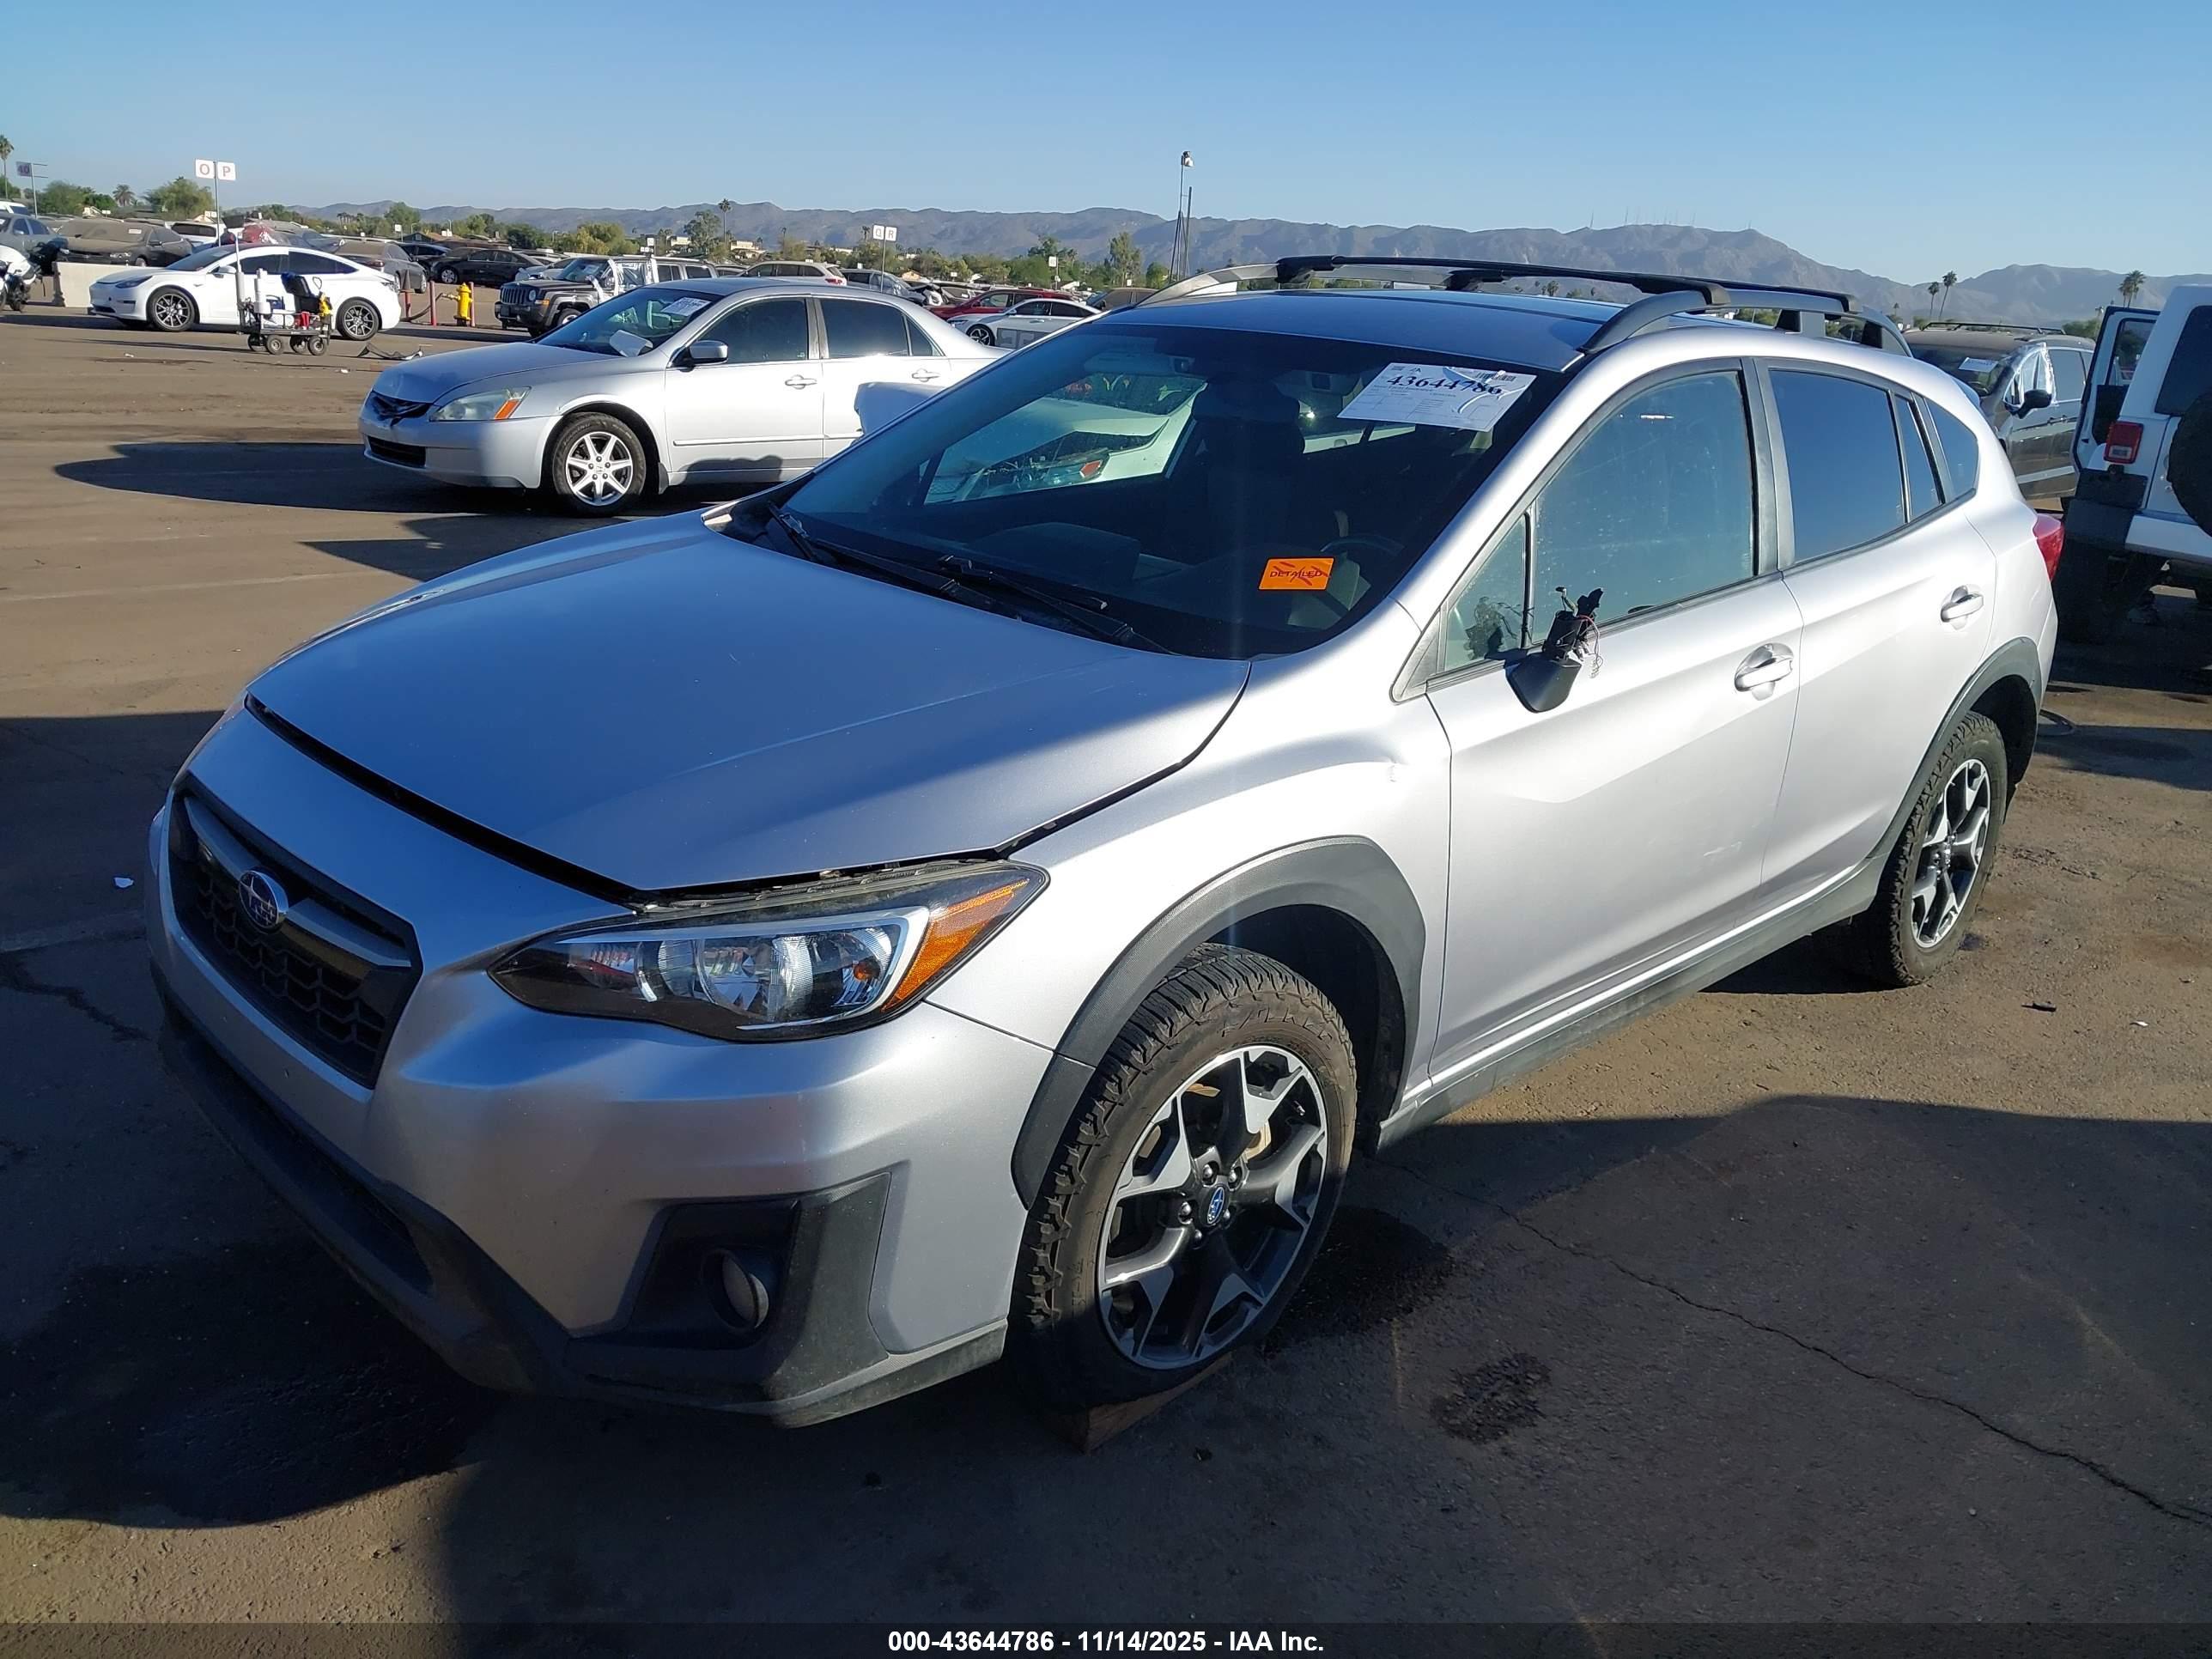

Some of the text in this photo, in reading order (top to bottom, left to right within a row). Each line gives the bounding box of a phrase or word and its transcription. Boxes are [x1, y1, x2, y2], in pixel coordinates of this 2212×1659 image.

[199, 163, 210, 175] O
[222, 166, 231, 177] P
[888, 229, 894, 239] R
[1386, 374, 1503, 395] 43644786
[1269, 570, 1323, 579] DETAILED
